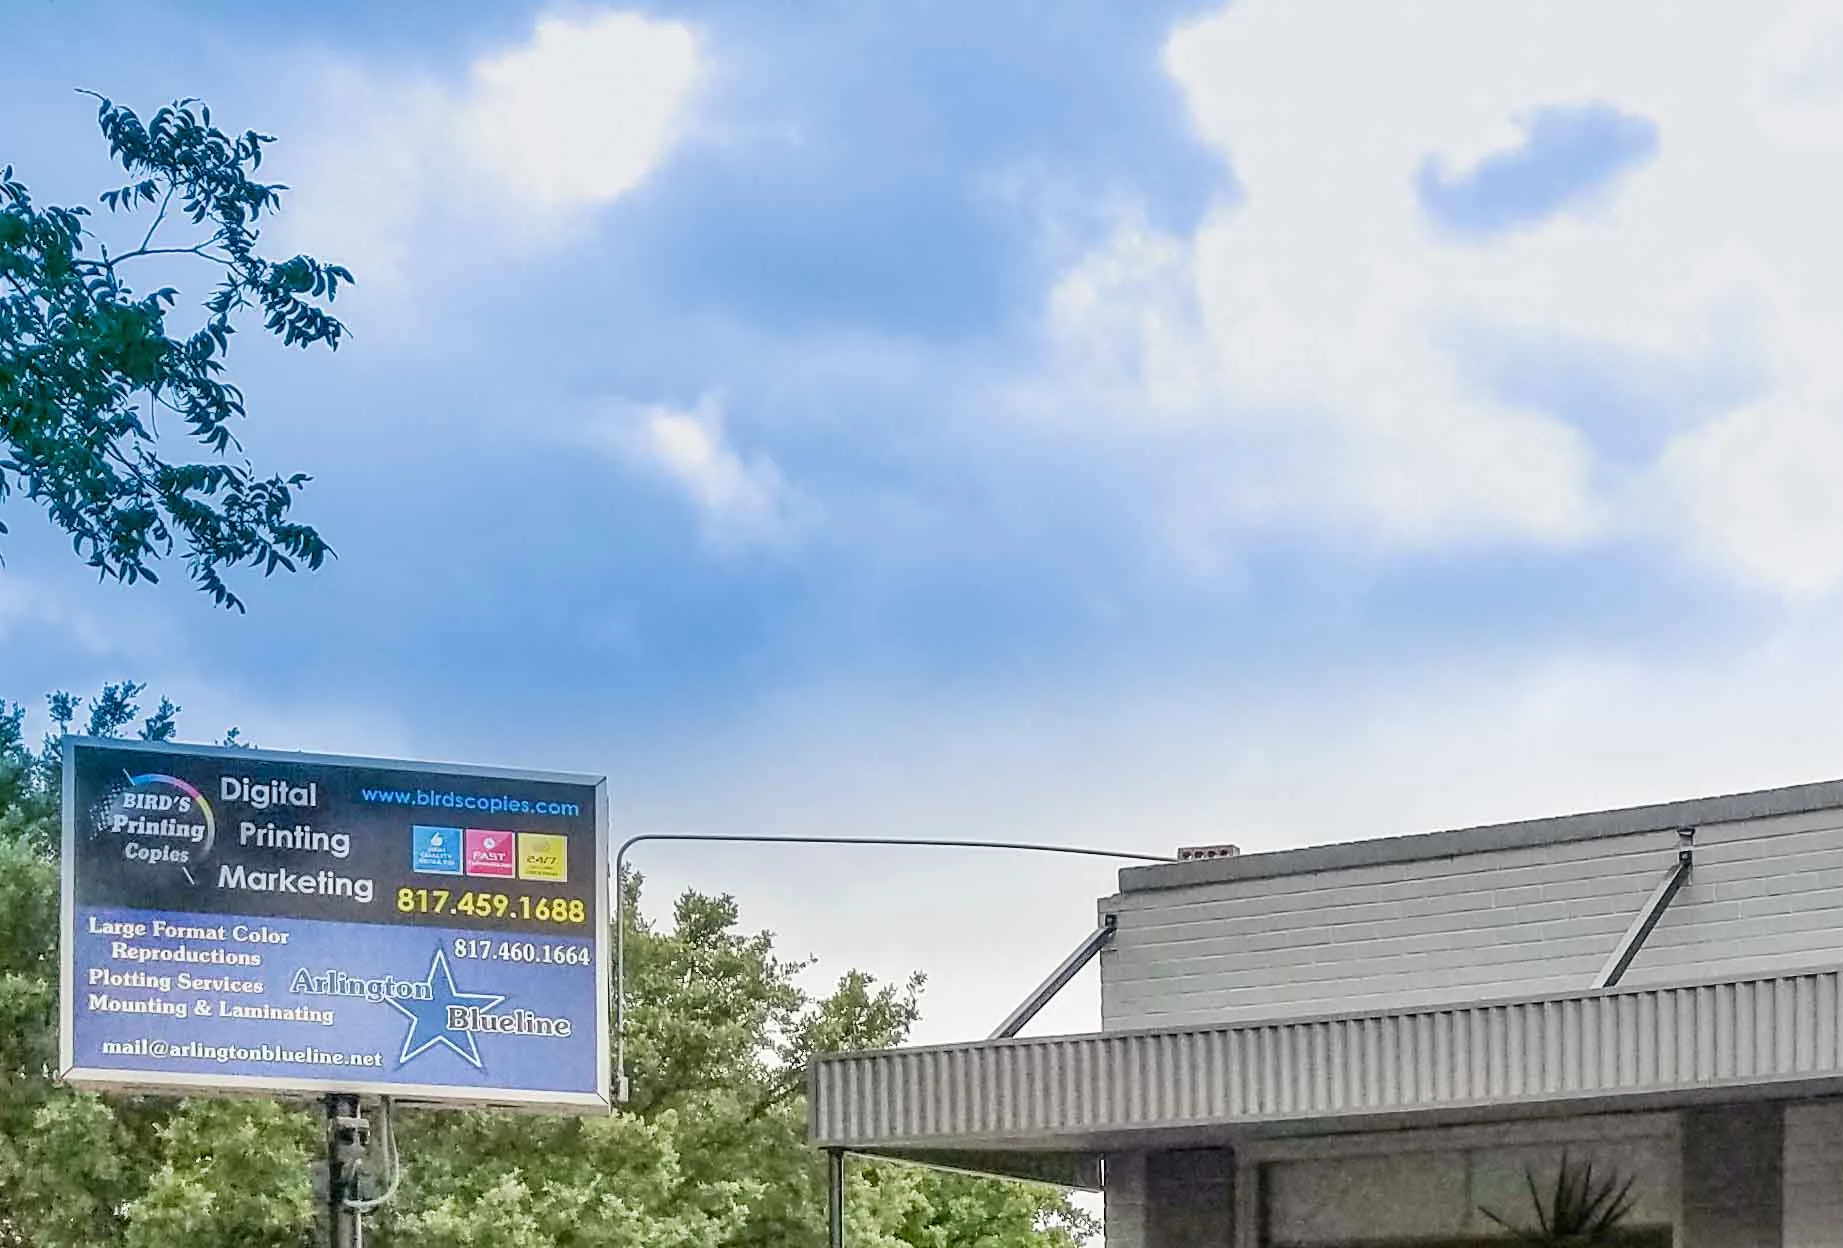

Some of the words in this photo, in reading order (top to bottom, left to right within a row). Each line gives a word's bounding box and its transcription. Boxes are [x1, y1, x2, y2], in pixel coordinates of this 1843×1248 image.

[122, 792, 192, 813] BIRD'S
[220, 776, 318, 810] Digital
[362, 787, 580, 817] www.birdscopies.com
[111, 814, 206, 843] Printing
[239, 822, 351, 859] Printing
[125, 842, 190, 864] Copies
[472, 851, 506, 862] FAST
[218, 864, 374, 903] Marketing
[397, 887, 585, 924] 817.459.1688
[88, 916, 146, 939] Large
[152, 920, 226, 941] Format
[232, 925, 290, 945] Color
[111, 941, 262, 967] Reproductions
[454, 938, 591, 966] 817.460.1664
[88, 968, 172, 992] Plotting
[177, 972, 264, 994] Services
[289, 967, 434, 1003] Arlington
[88, 993, 188, 1018] Mounting
[193, 999, 213, 1016] &
[218, 1000, 335, 1026] Laminating
[446, 1005, 572, 1037] Blueline
[102, 1039, 384, 1067] mail@arlingtonblueline.net
